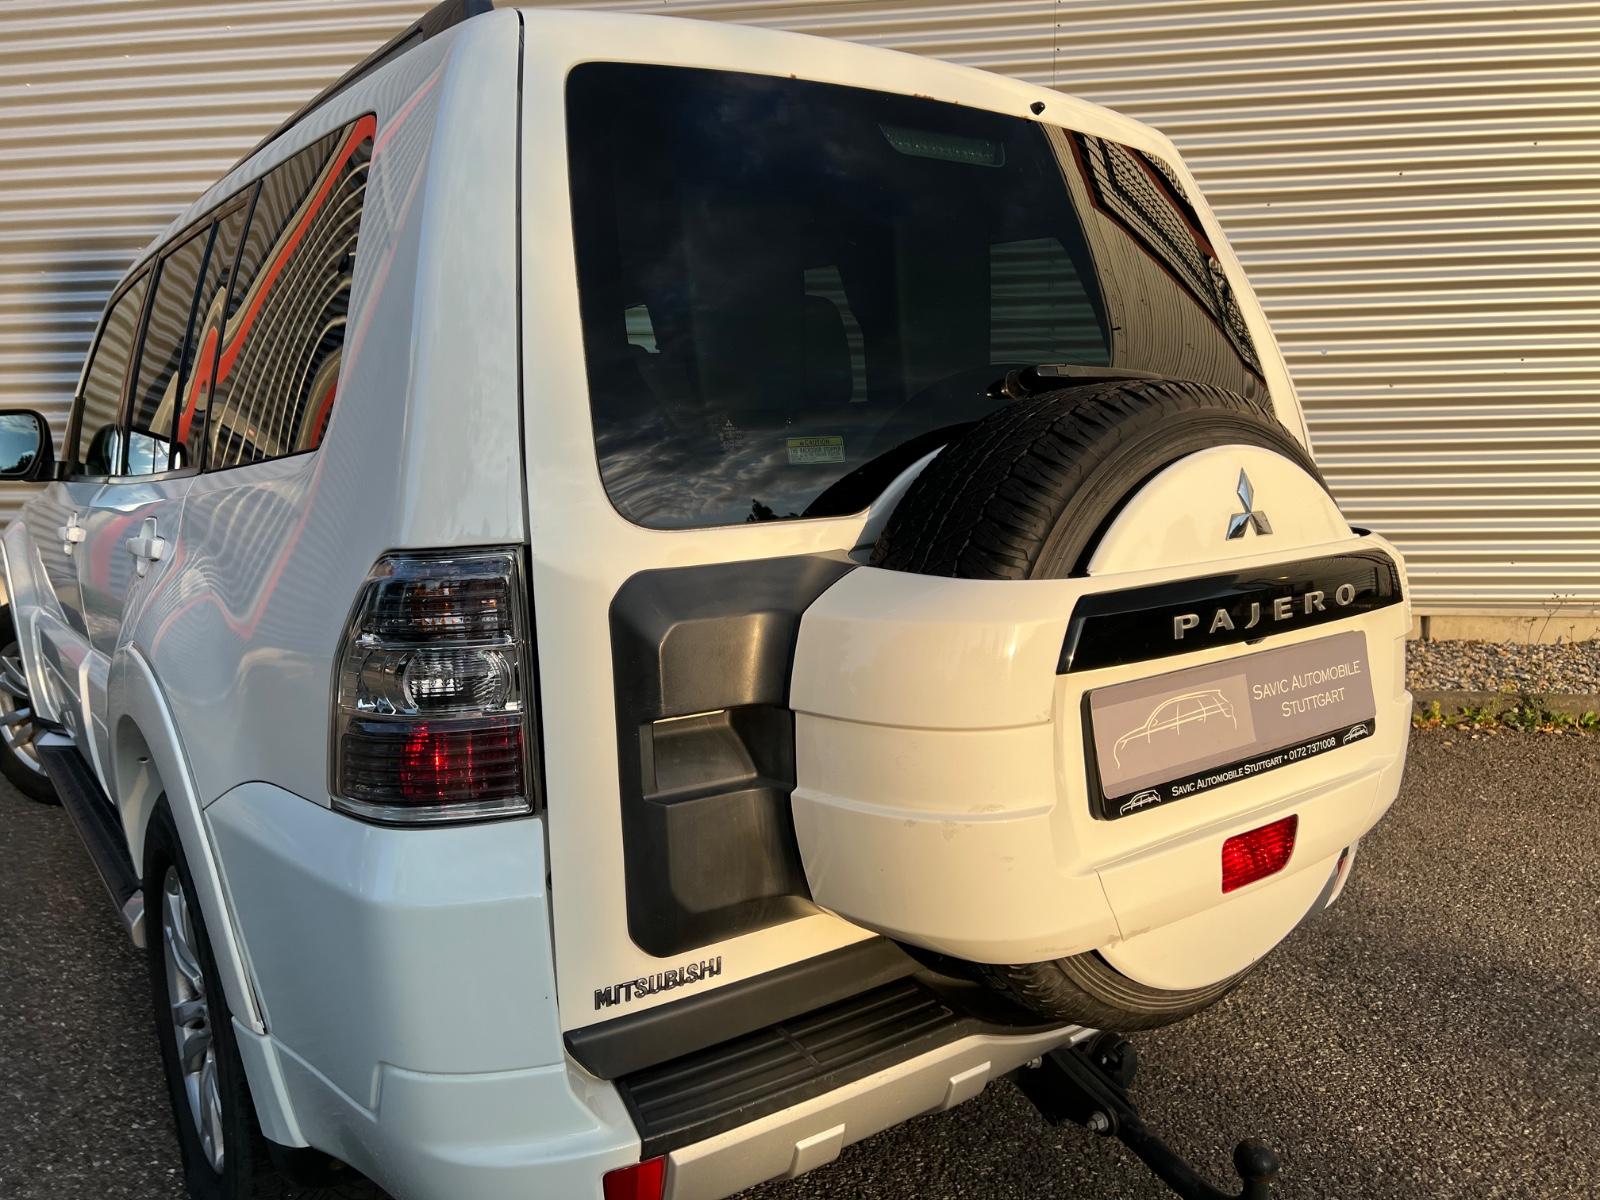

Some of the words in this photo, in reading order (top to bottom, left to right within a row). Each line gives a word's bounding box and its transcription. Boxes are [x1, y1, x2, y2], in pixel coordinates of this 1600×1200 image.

[1173, 583, 1356, 640] PAJERO
[1252, 679, 1289, 701] SAVIC
[1291, 660, 1361, 691] AUTOMOBILE
[1281, 687, 1345, 717] STUTTGART
[1171, 782, 1196, 797] SAVIC
[1196, 769, 1244, 790] AUTOMOBILE
[1244, 755, 1283, 775] STUTTGART
[1288, 746, 1307, 761] 0172
[594, 956, 722, 1011] MITSUBISHI
